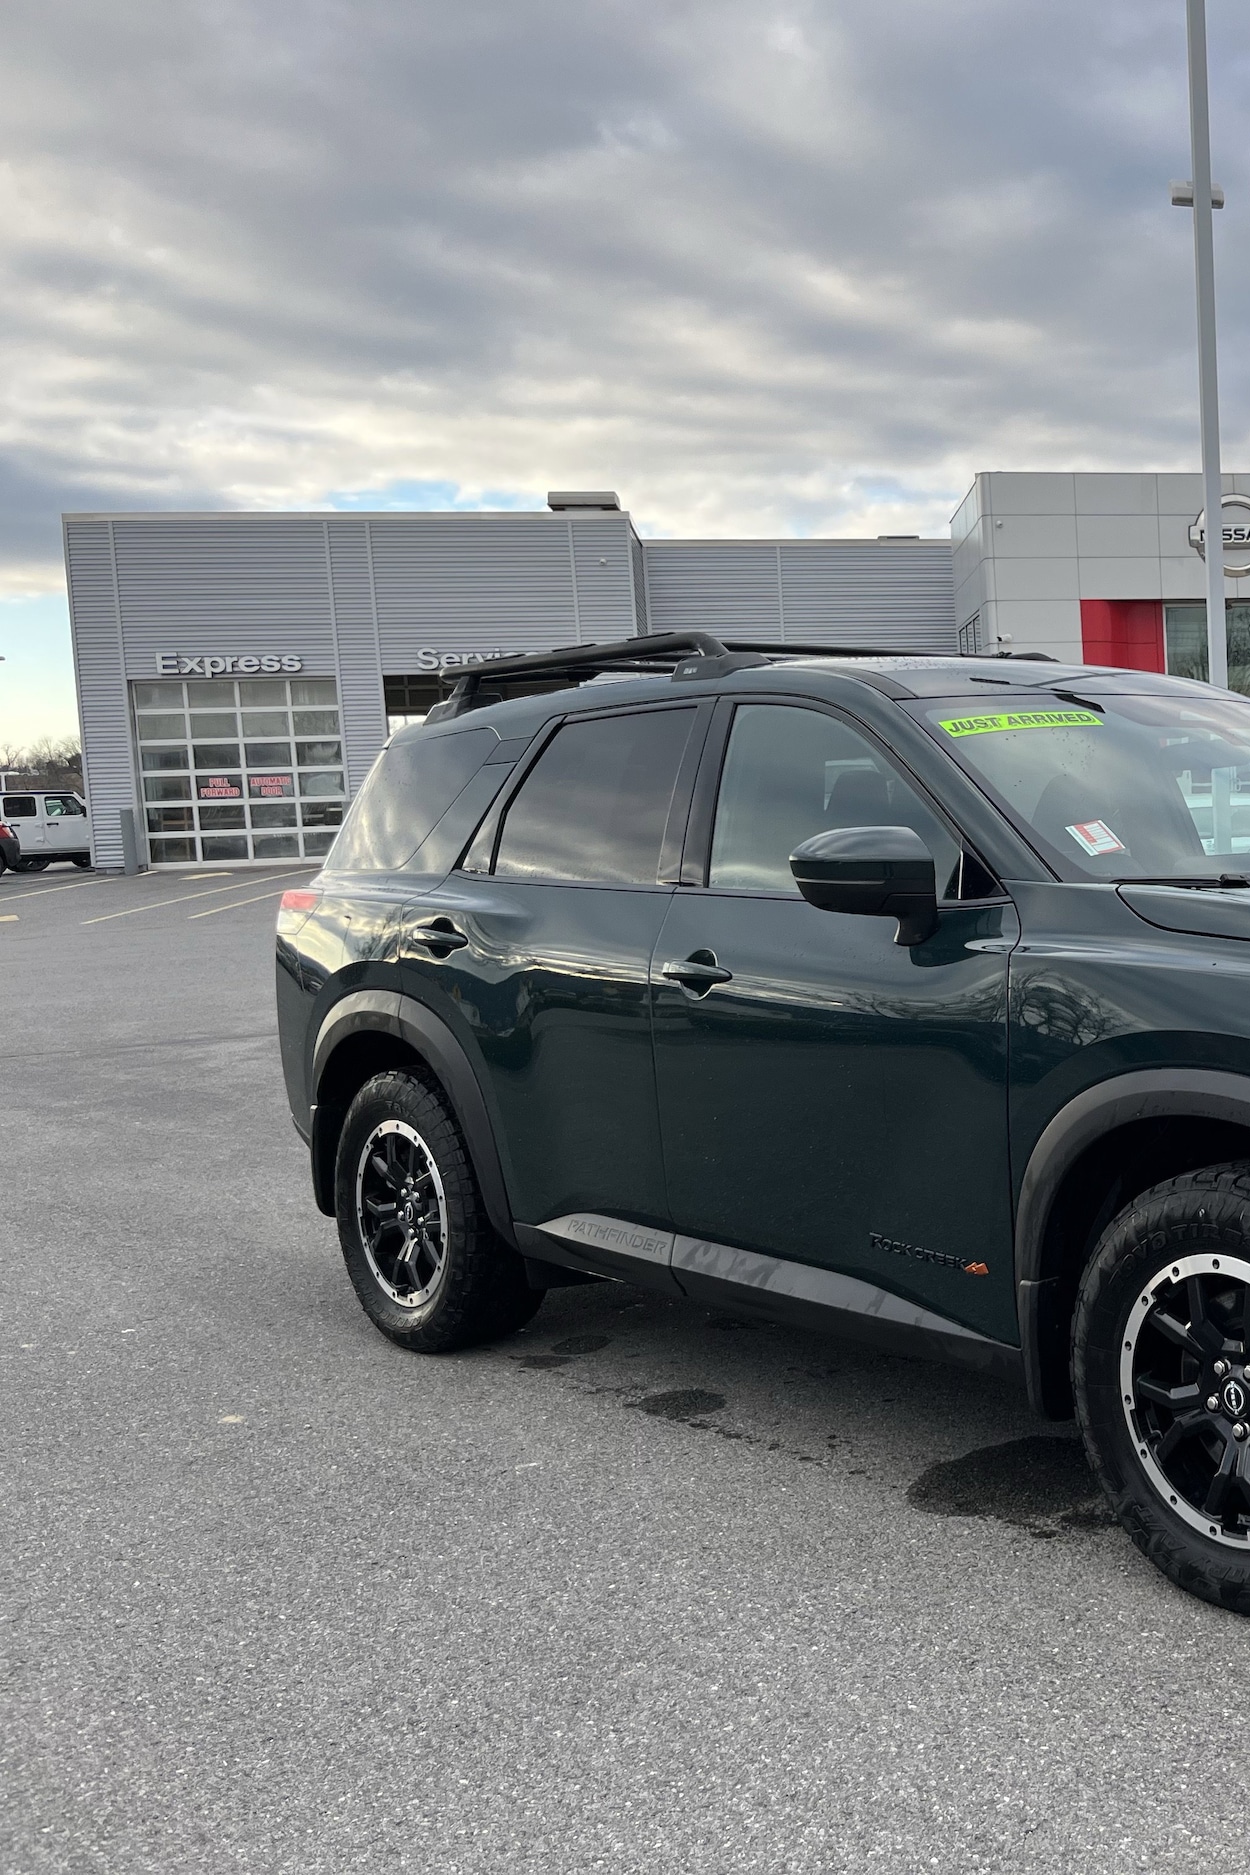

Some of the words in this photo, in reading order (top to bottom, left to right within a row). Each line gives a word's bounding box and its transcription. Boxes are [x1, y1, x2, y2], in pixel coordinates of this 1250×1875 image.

[155, 651, 303, 679] Express
[948, 716, 1001, 734] JUST
[1007, 712, 1095, 727] ARRIVED
[208, 777, 231, 788] PULL
[249, 776, 291, 787] AUTOMATIC
[200, 787, 240, 798] FORWARD
[261, 786, 283, 797] DOOR
[567, 1218, 668, 1256] PATHFINDER
[869, 1231, 912, 1257] ROCK
[914, 1246, 967, 1271] CREEK
